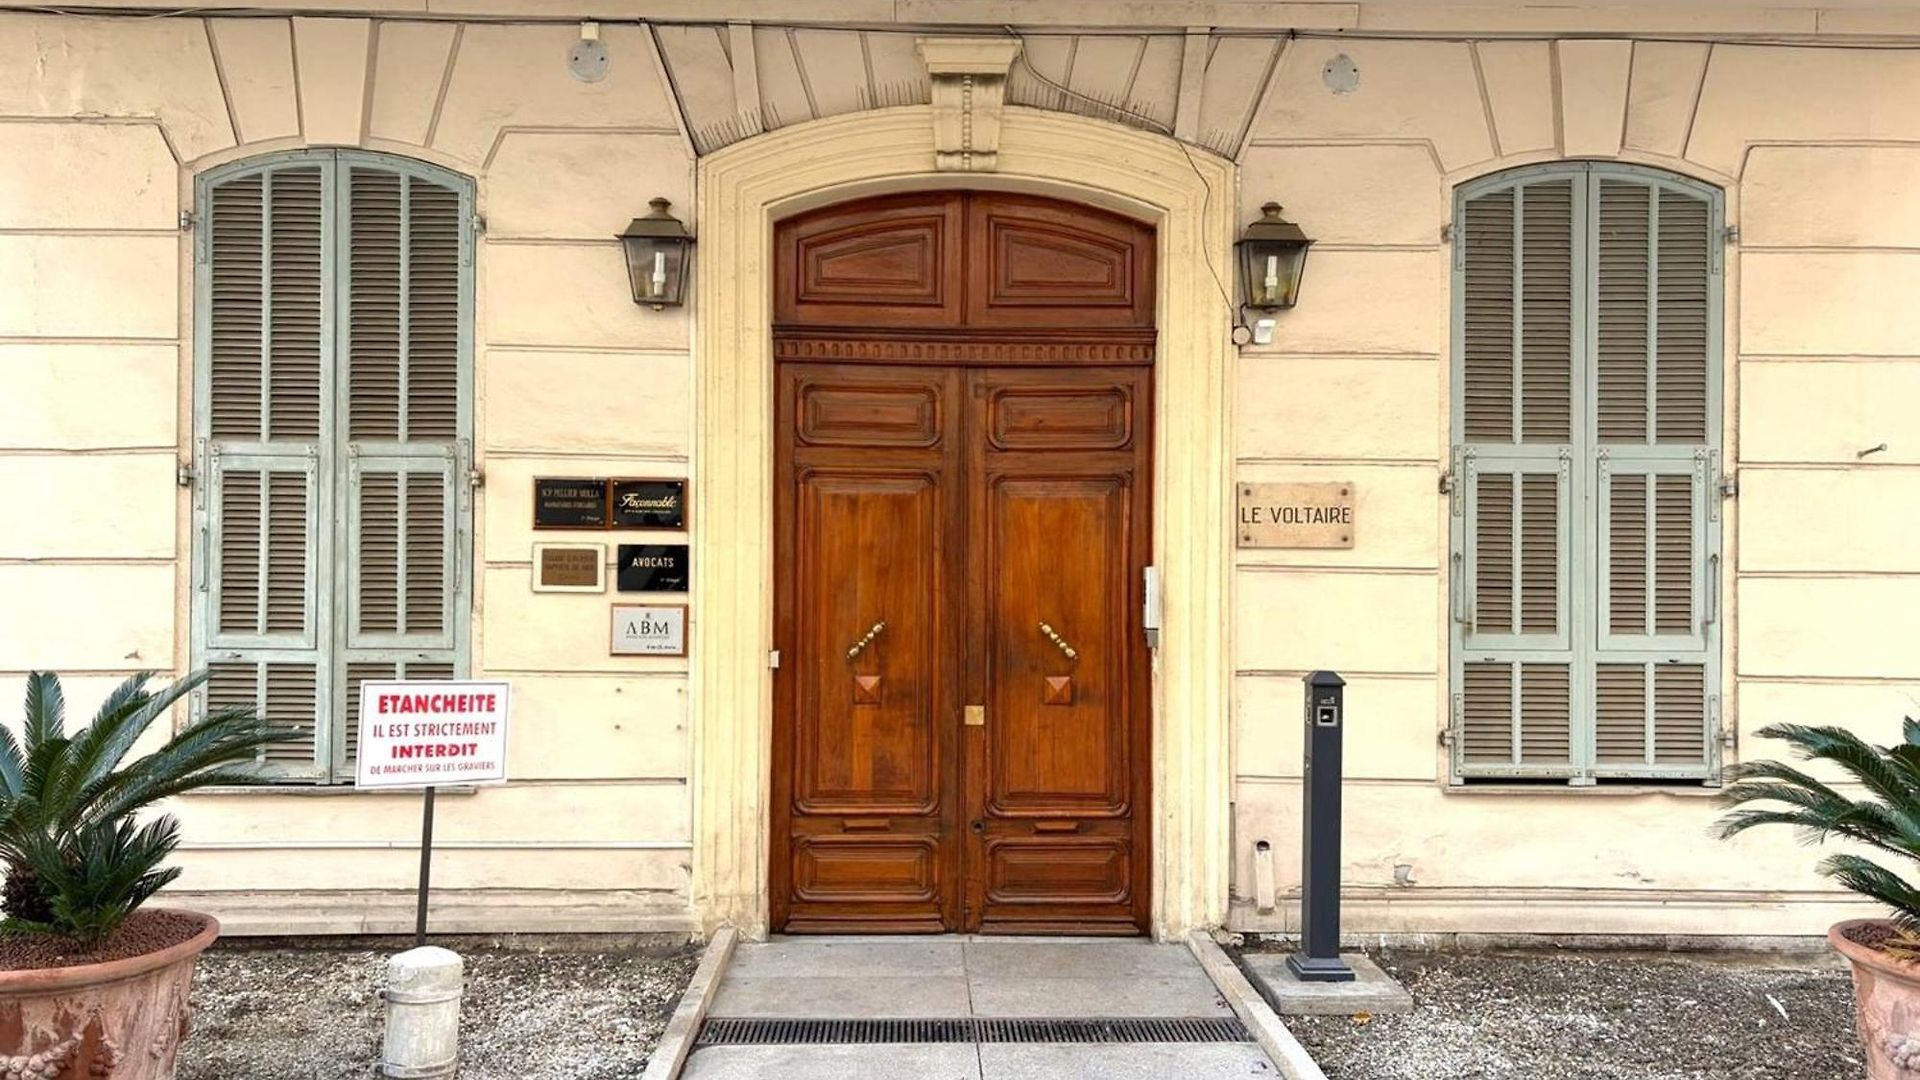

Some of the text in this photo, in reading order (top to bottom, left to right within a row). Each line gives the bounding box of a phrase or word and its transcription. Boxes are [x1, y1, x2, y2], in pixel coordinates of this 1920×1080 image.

[1241, 507, 1351, 524] LE VOLTAIRE
[631, 557, 674, 568] AVOCATS
[626, 621, 669, 635] ABM
[378, 694, 496, 714] ETANCHEITE
[373, 722, 497, 738] IL EST STRICTEMENT
[391, 743, 478, 759] INTERDIT
[370, 761, 496, 775] DE MARCHER SUR LES GRAVIERS
